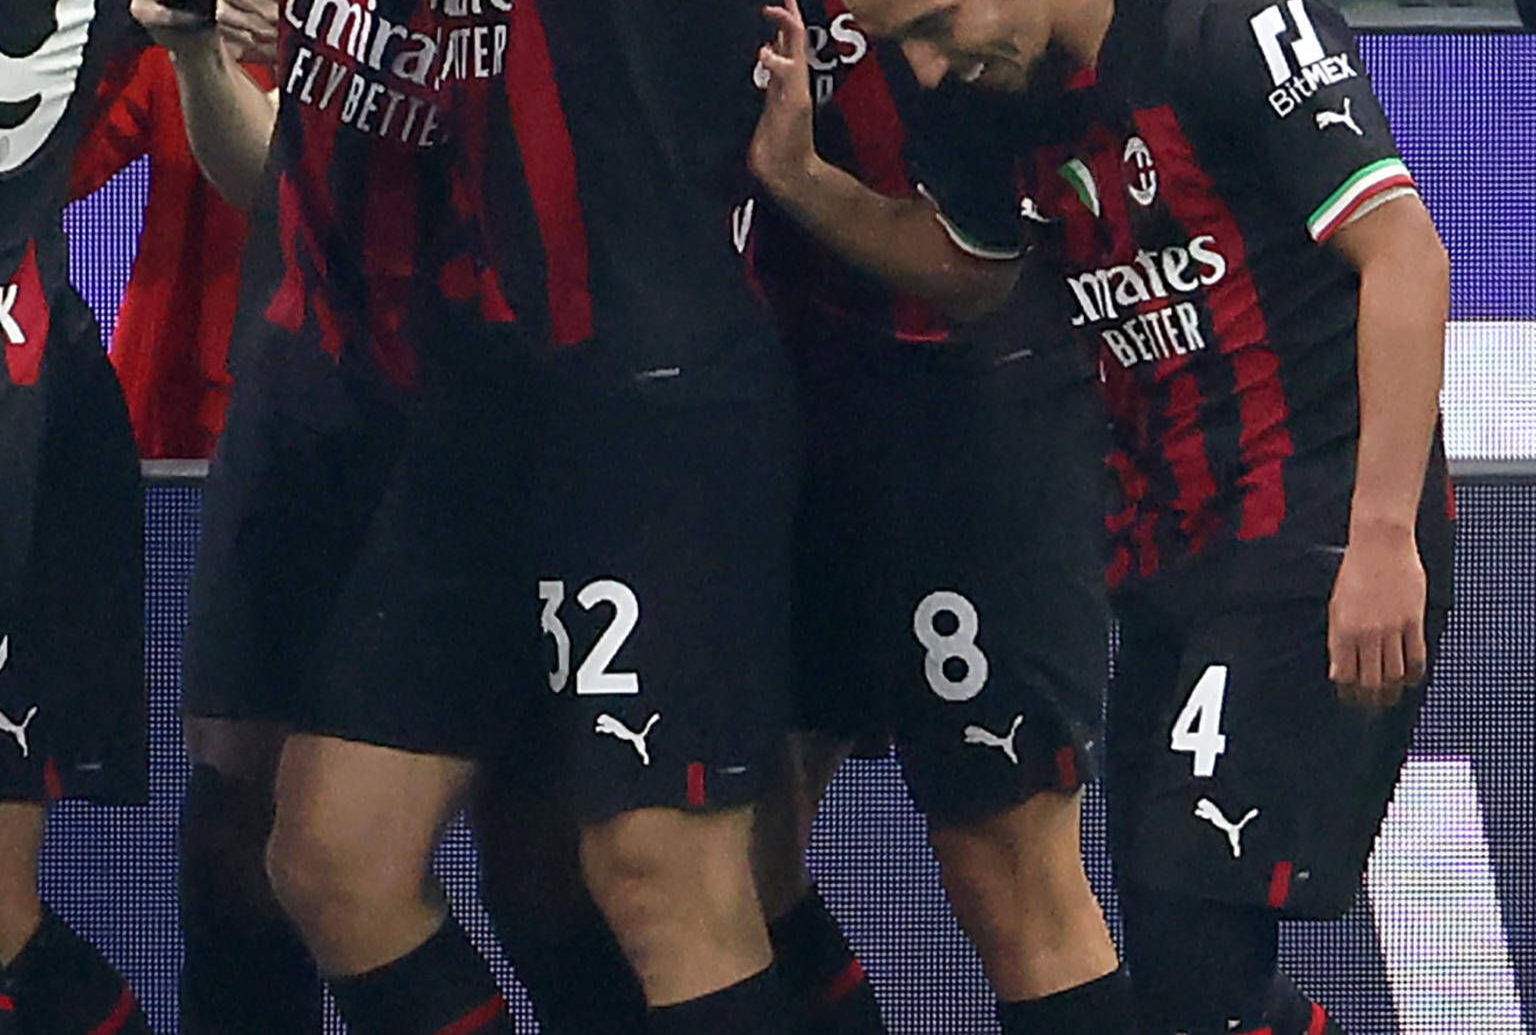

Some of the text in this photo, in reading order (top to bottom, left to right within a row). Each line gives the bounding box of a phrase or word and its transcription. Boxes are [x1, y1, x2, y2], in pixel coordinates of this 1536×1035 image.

[286, 47, 450, 148] FLY BETTE
[1268, 52, 1358, 119] BitMEX
[914, 590, 989, 702] 8
[1170, 664, 1228, 777] 4
